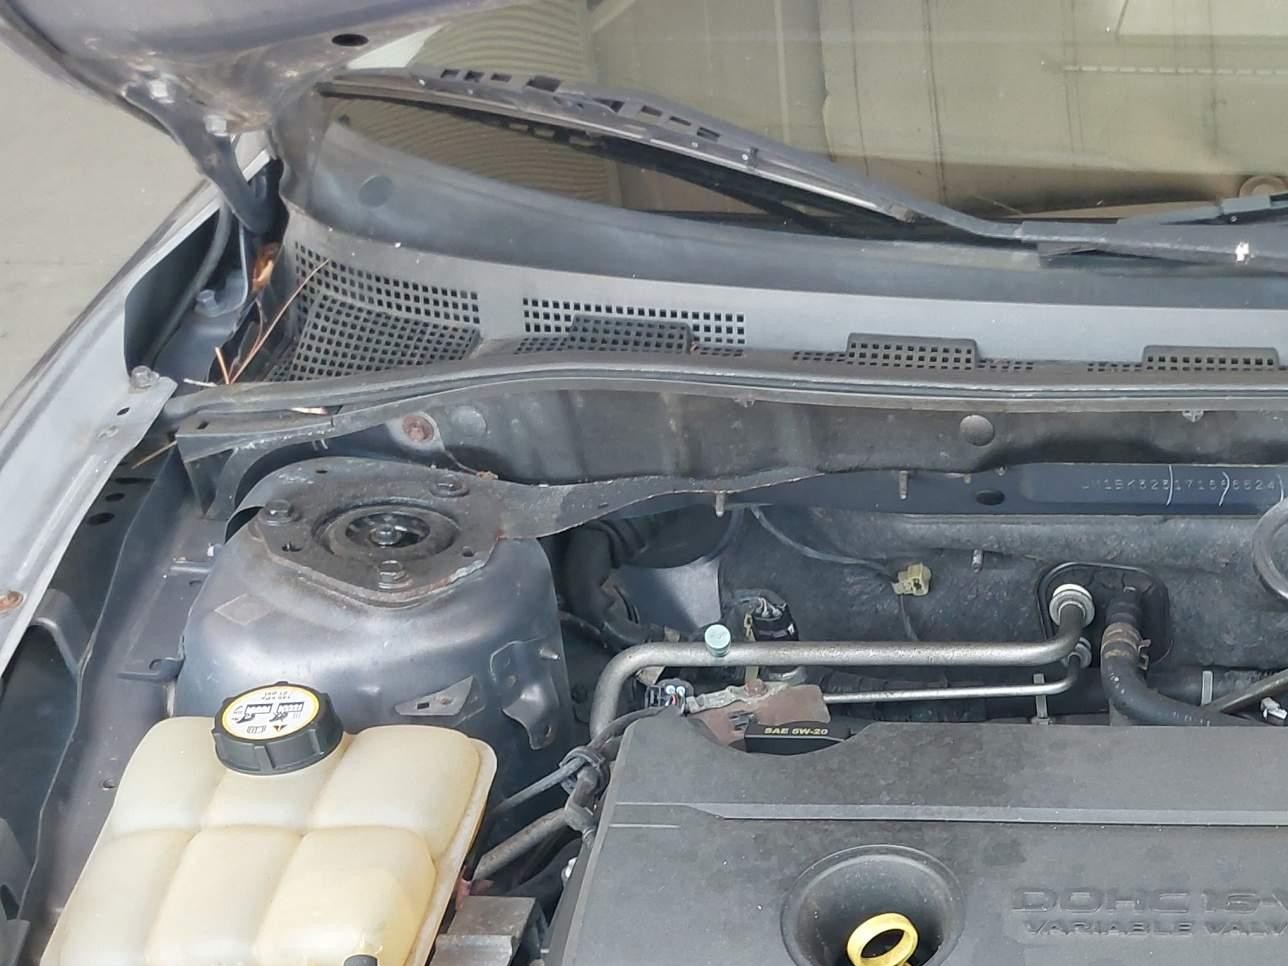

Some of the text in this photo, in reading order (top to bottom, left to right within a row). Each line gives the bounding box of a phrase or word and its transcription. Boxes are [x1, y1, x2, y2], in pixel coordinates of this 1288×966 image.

[764, 727, 789, 735] SAE
[1011, 888, 1189, 915] DOHC
[1022, 920, 1193, 936] VARIABLE
